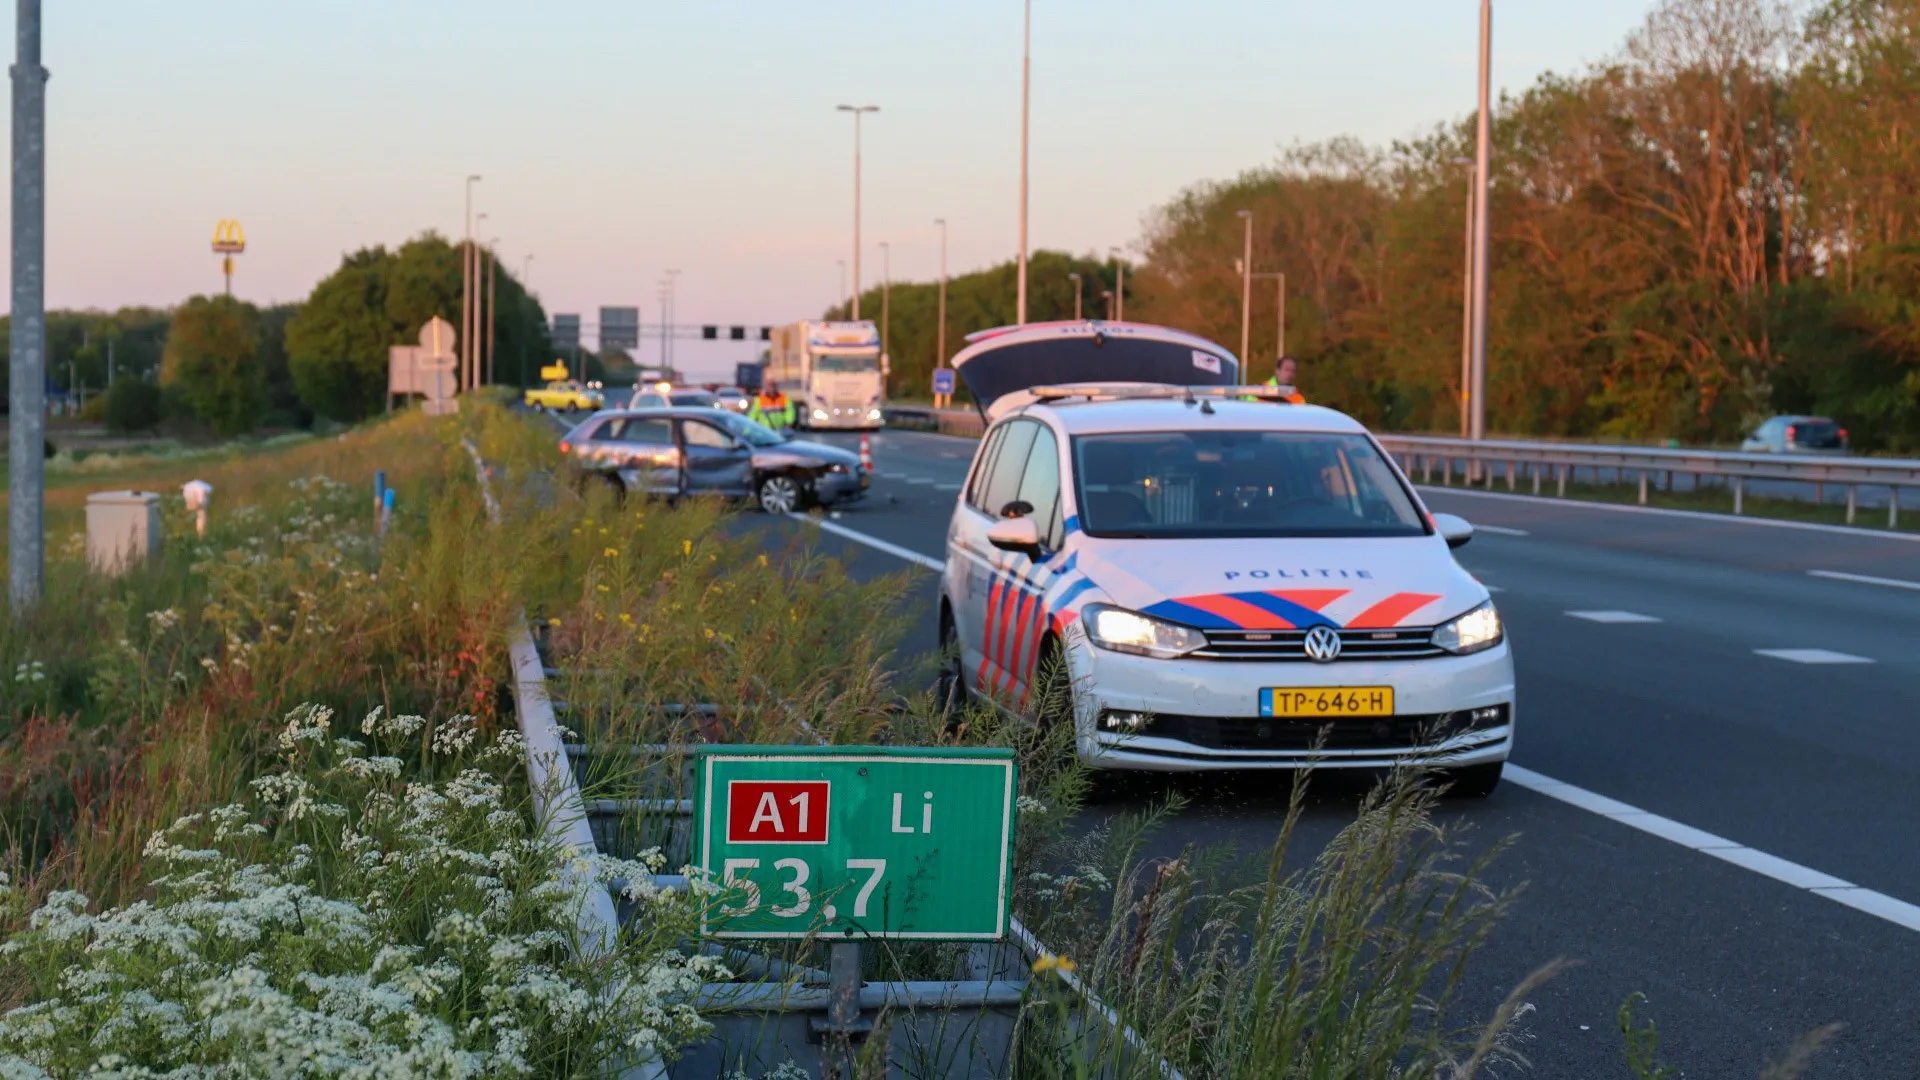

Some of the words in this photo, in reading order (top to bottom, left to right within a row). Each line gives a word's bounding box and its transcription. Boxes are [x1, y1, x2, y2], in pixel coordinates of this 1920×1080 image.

[1224, 568, 1375, 580] POLITIE
[1279, 691, 1384, 713] TP-646-H
[749, 791, 809, 833] A1
[892, 791, 933, 834] Li
[719, 857, 887, 926] 53,7
